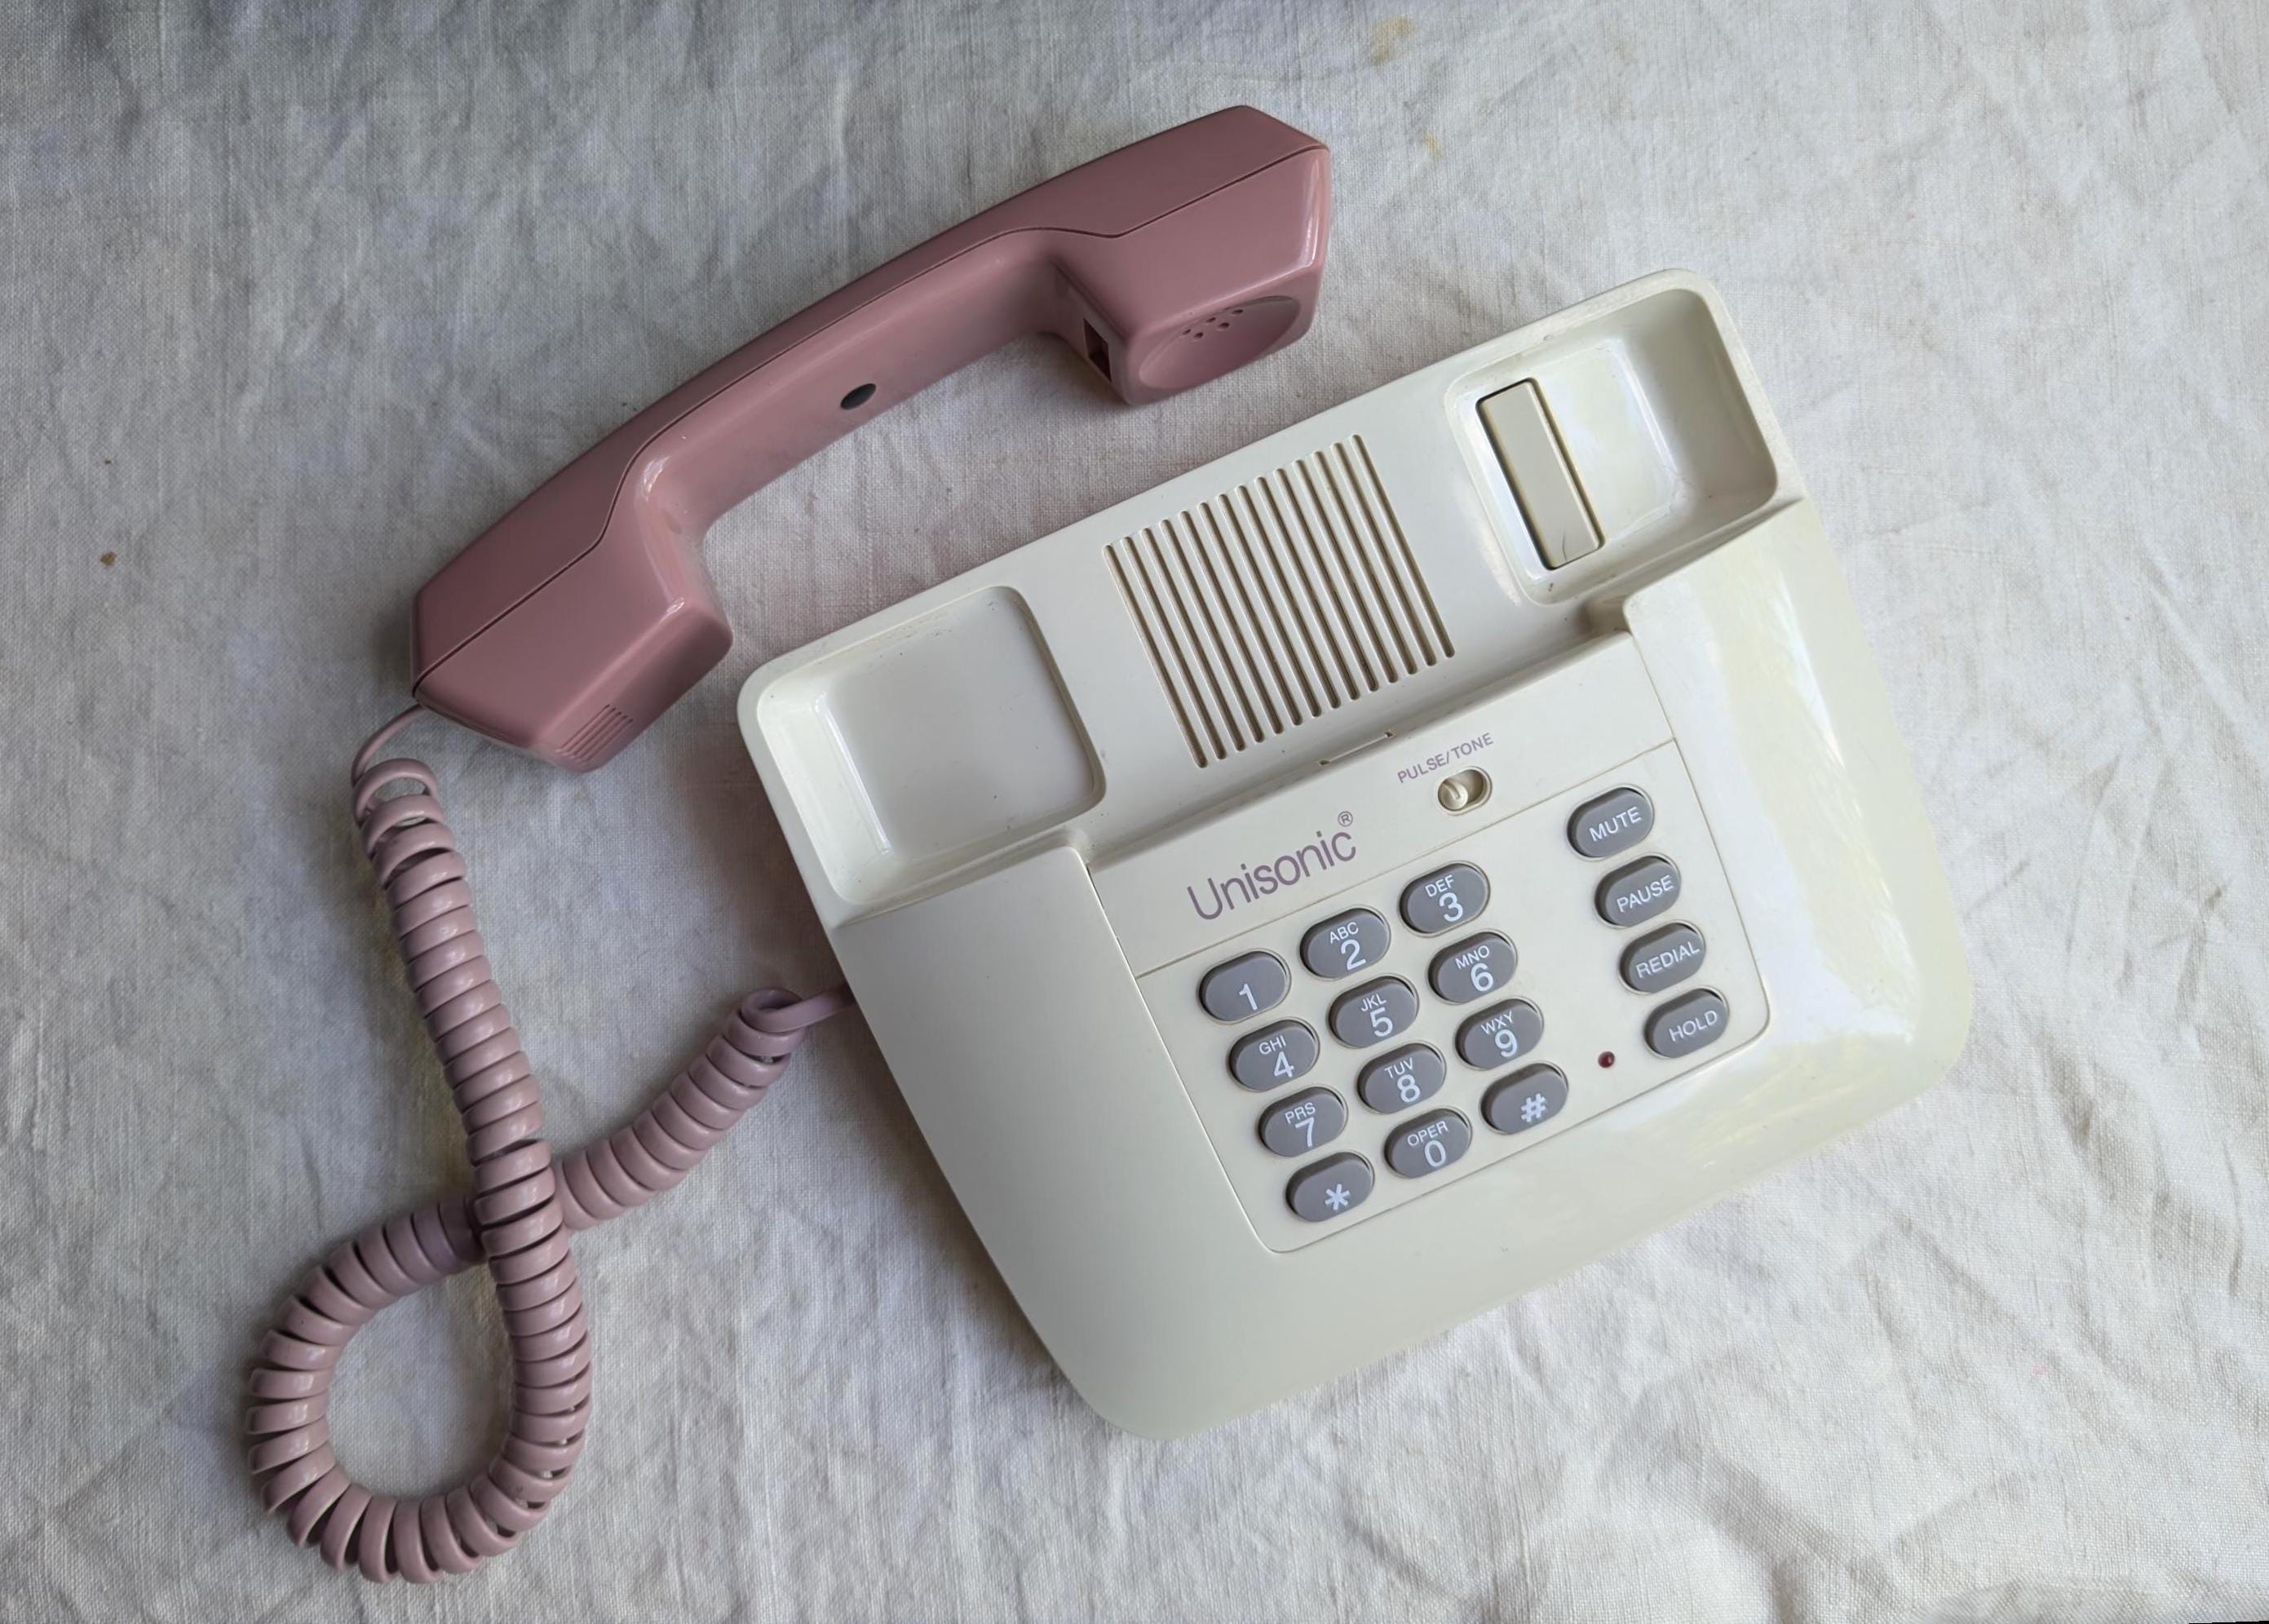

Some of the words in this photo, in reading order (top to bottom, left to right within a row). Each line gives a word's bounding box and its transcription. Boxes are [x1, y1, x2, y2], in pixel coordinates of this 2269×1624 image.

[1397, 733, 1493, 783] PULSE/TONE
[1589, 806, 1642, 843] MUTE
[1425, 874, 1455, 897] DEF
[1617, 874, 1674, 912] PAUSE
[1439, 892, 1463, 923] 3
[1330, 922, 1360, 945] ABC
[1341, 940, 1367, 971] 2
[1455, 945, 1490, 970] MNO
[1636, 941, 1700, 979] REDIAL
[1471, 962, 1494, 992] 6
[1239, 983, 1258, 1011] 1
[1361, 993, 1387, 1013] JKL
[1369, 1007, 1393, 1038] 5
[1480, 1011, 1515, 1036] WXY
[1669, 1010, 1718, 1043] HOLD
[1258, 1035, 1287, 1055] GHI
[1494, 1029, 1518, 1058] 9
[1274, 1051, 1295, 1078] 4
[1384, 1057, 1414, 1079] TUV
[1397, 1074, 1421, 1103] 8
[1285, 1102, 1316, 1124] PRS
[1521, 1093, 1547, 1123] #
[1294, 1117, 1316, 1148] 7
[1407, 1121, 1449, 1147] OPER
[1424, 1139, 1447, 1167] 0
